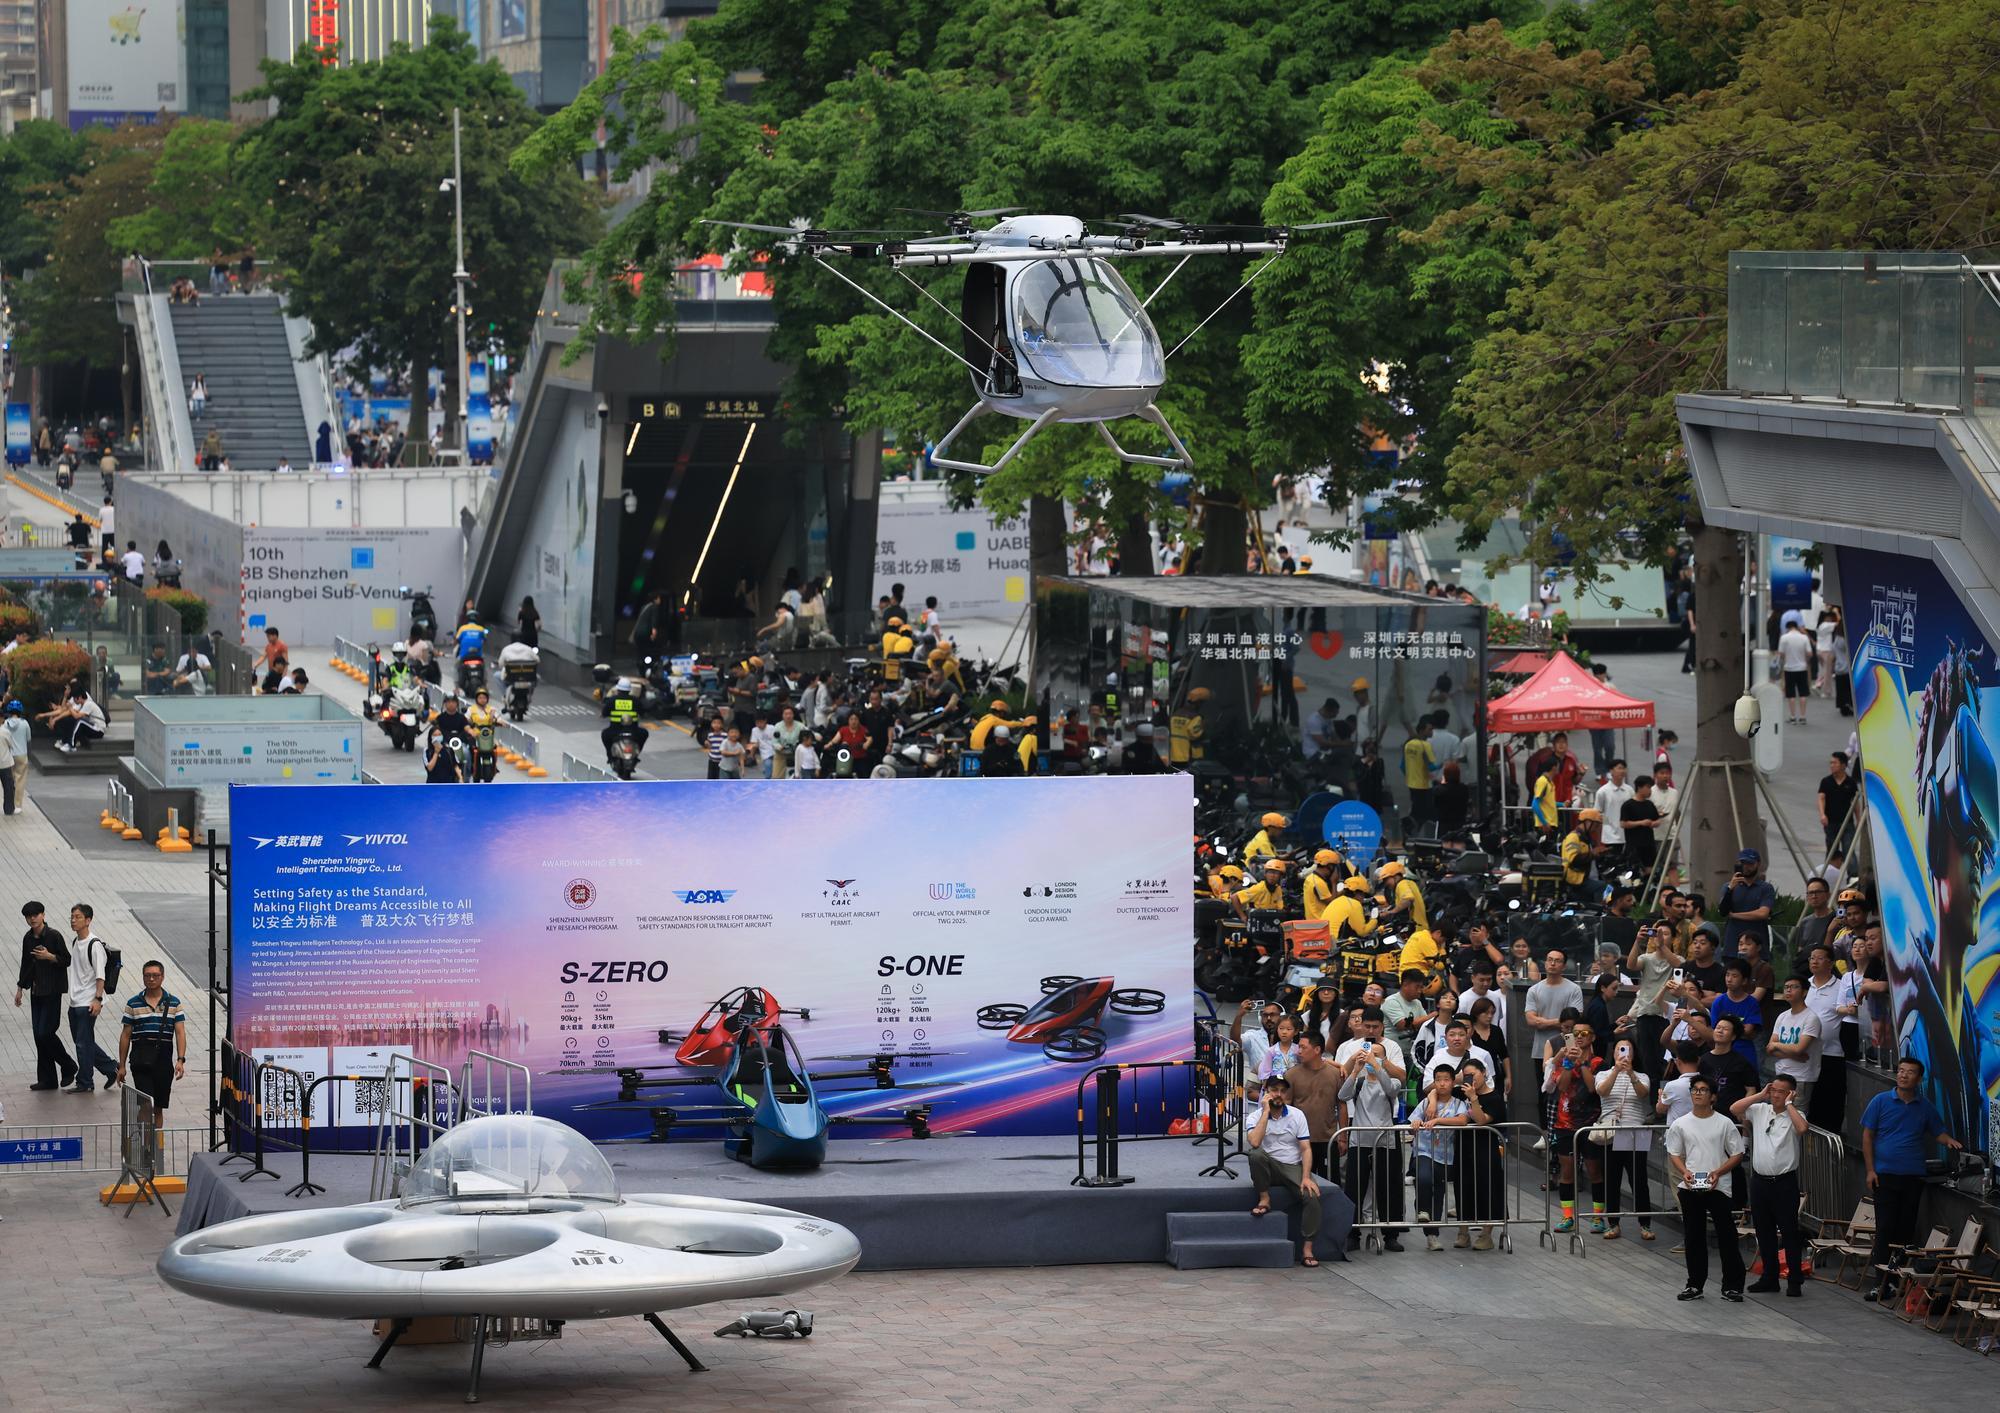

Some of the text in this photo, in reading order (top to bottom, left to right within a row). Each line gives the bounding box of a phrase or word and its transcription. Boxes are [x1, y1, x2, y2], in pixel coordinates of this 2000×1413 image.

[643, 404, 655, 417] B
[706, 402, 758, 412] 华强北站
[249, 547, 284, 560] 10th
[988, 558, 1030, 572] Huaq
[268, 566, 348, 580] Shenzhen
[1188, 633, 1303, 645] 深圳市血液中心
[1364, 632, 1462, 644] 深圳市无偿献血
[1200, 647, 1287, 660] 华强北捐血站
[1349, 647, 1476, 659] 新时代文明实践中心
[1610, 709, 1645, 720] 83321999
[275, 835, 324, 847] 英武智能
[364, 834, 409, 845] YIVTOL
[346, 856, 375, 866] Yingwu
[276, 866, 317, 874] Intelligent
[320, 865, 367, 873] Technology
[369, 864, 384, 873] Co.,
[254, 888, 294, 900] Setting
[298, 887, 333, 899] Safety
[351, 887, 370, 896] the
[373, 886, 427, 898] Standard,
[685, 890, 725, 903] AOPA
[254, 899, 472, 914] Making Flight Dreams Accessible to All
[252, 913, 474, 929] 以安全为标准 普及大众飞行梦想
[878, 954, 964, 976] S-ONE
[560, 960, 668, 984] S-ZERO
[560, 1015, 583, 1023] 90kg+
[14, 1142, 61, 1152] 人行通道
